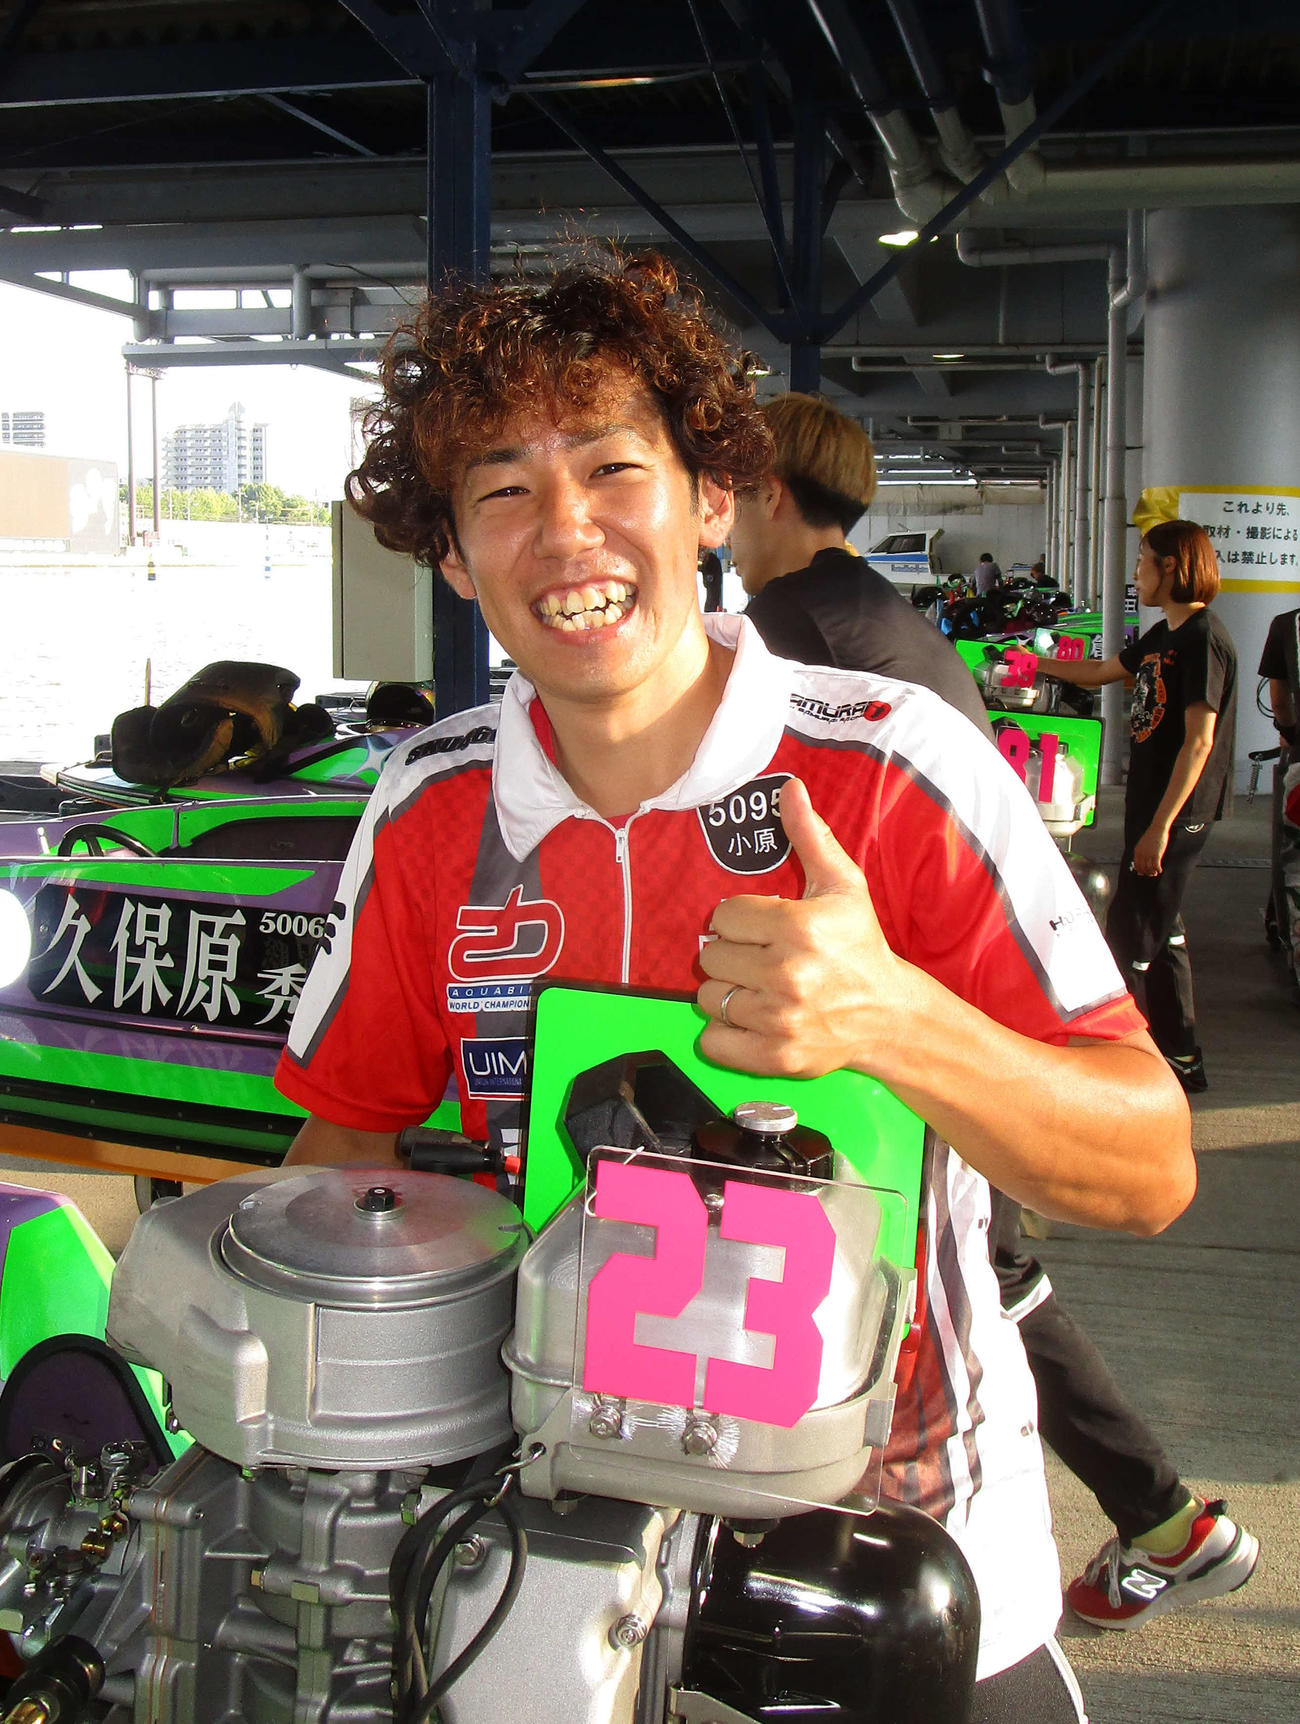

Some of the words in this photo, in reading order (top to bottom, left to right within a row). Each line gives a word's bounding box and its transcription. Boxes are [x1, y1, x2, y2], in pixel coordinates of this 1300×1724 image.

[1223, 501, 1290, 516] これより先、
[728, 828, 778, 856] 小原
[259, 912, 327, 939] 5006
[42, 893, 247, 1022] 久保原
[451, 985, 532, 997] AQUABI
[449, 1001, 480, 1010] WORLD
[469, 1051, 527, 1076] UIM
[583, 1160, 837, 1428] 23
